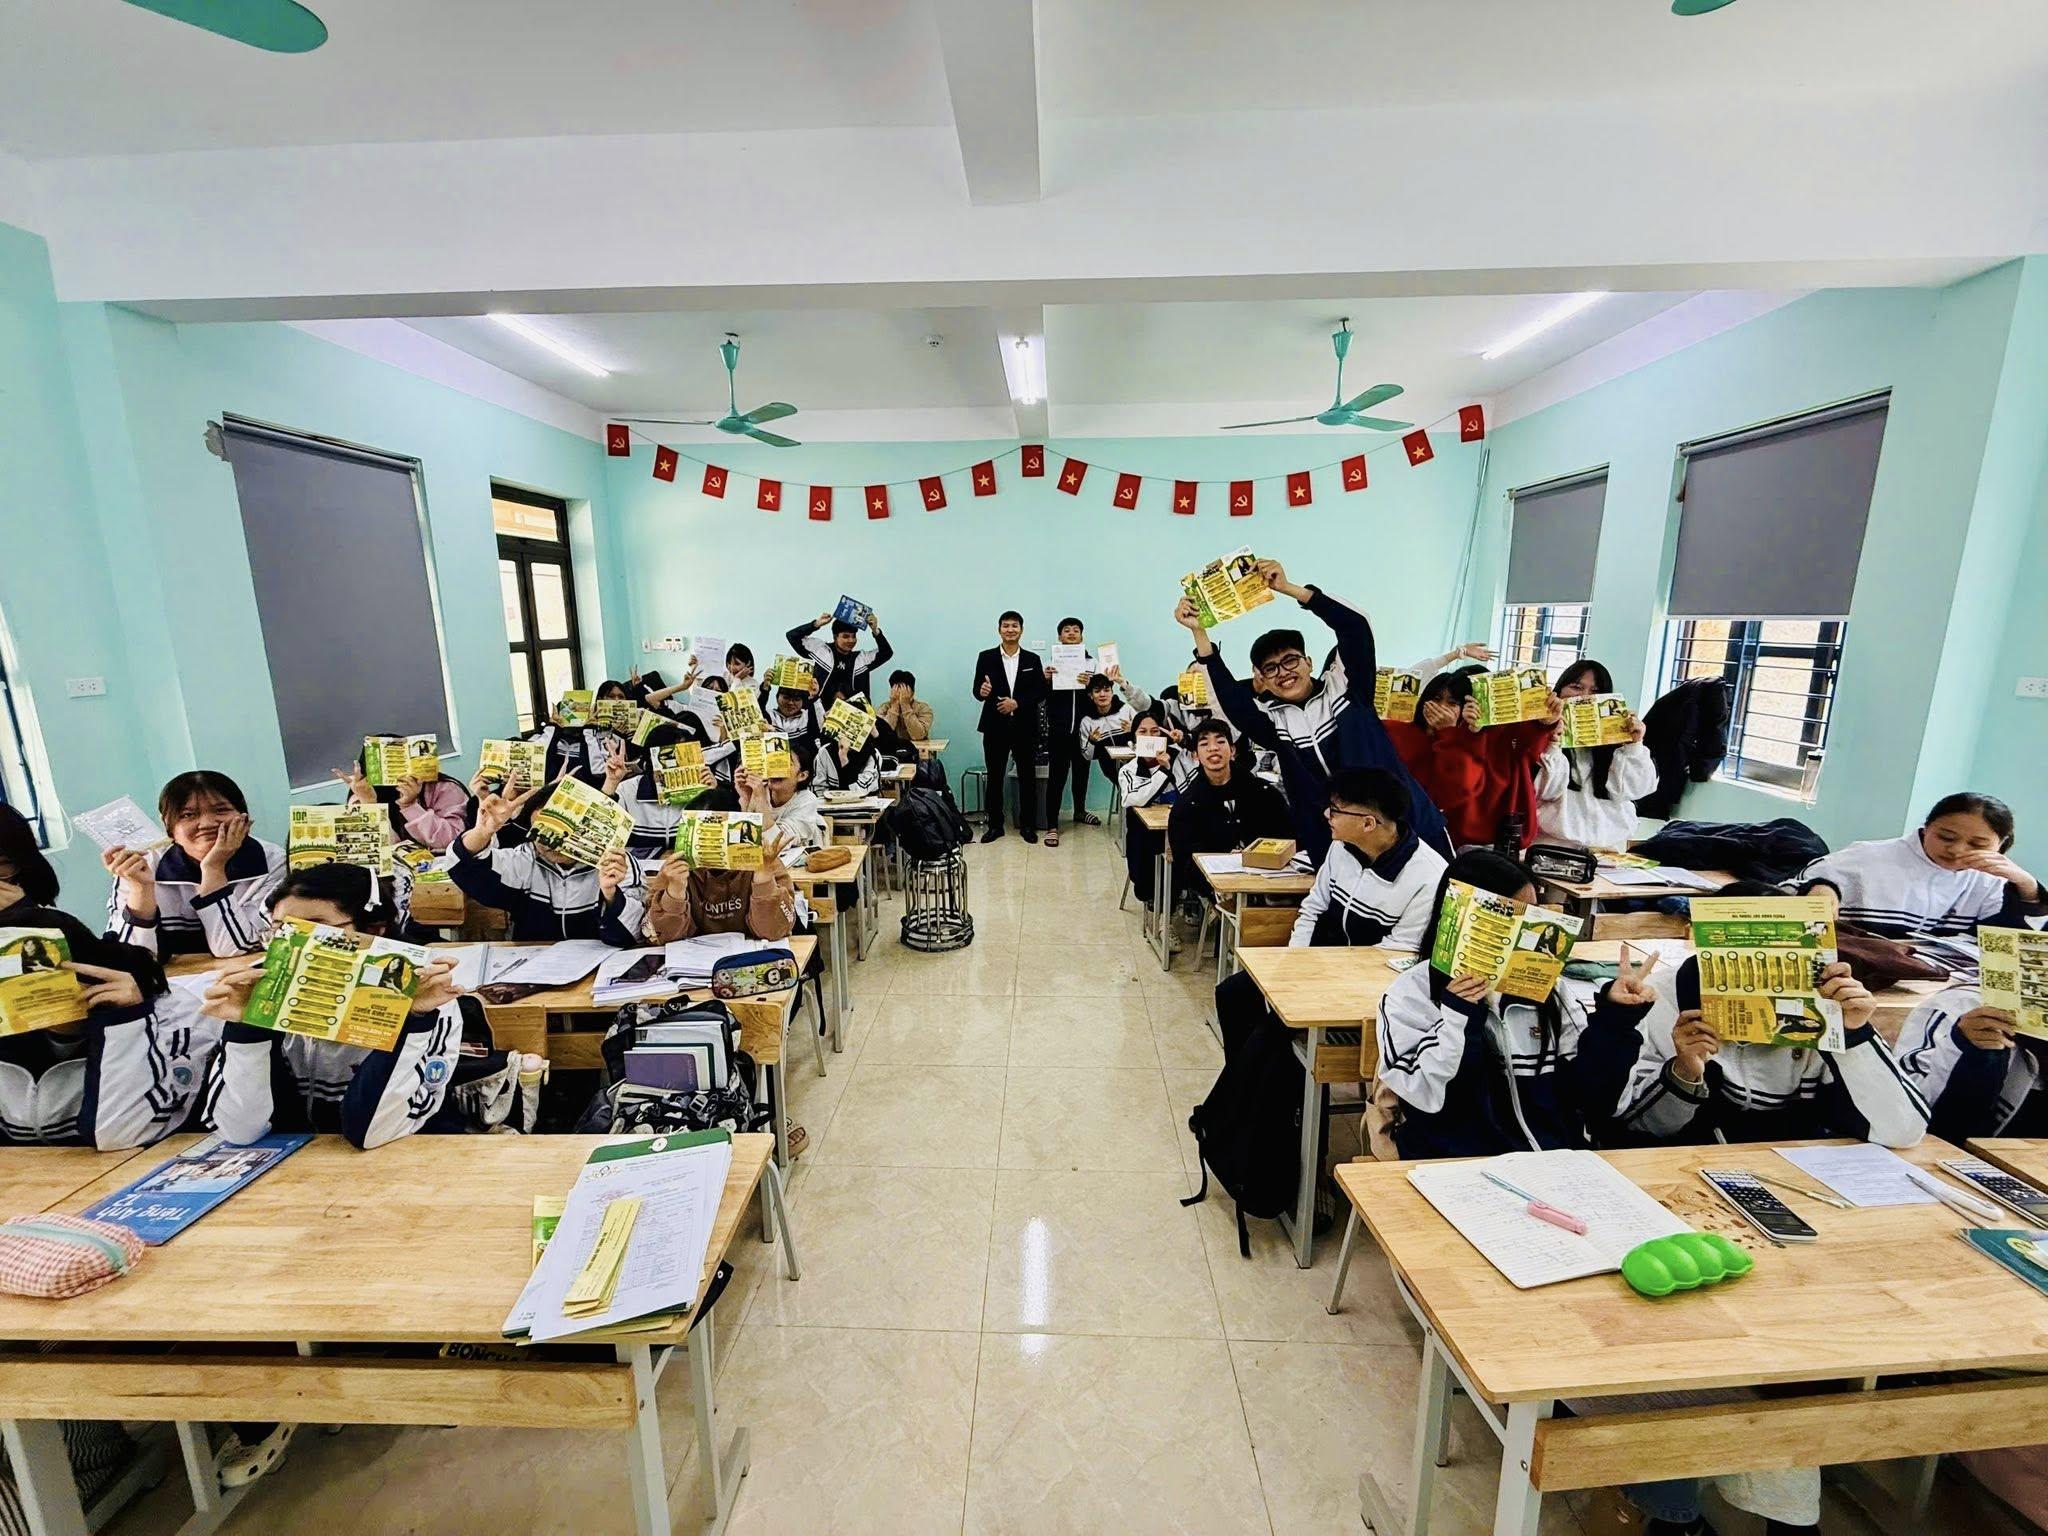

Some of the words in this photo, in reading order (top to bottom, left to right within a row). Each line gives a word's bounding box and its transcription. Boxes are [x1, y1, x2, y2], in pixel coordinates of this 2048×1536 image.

[113, 1194, 142, 1206] 12
[96, 1205, 138, 1221] Anh
[137, 1205, 189, 1222] Tiếng
